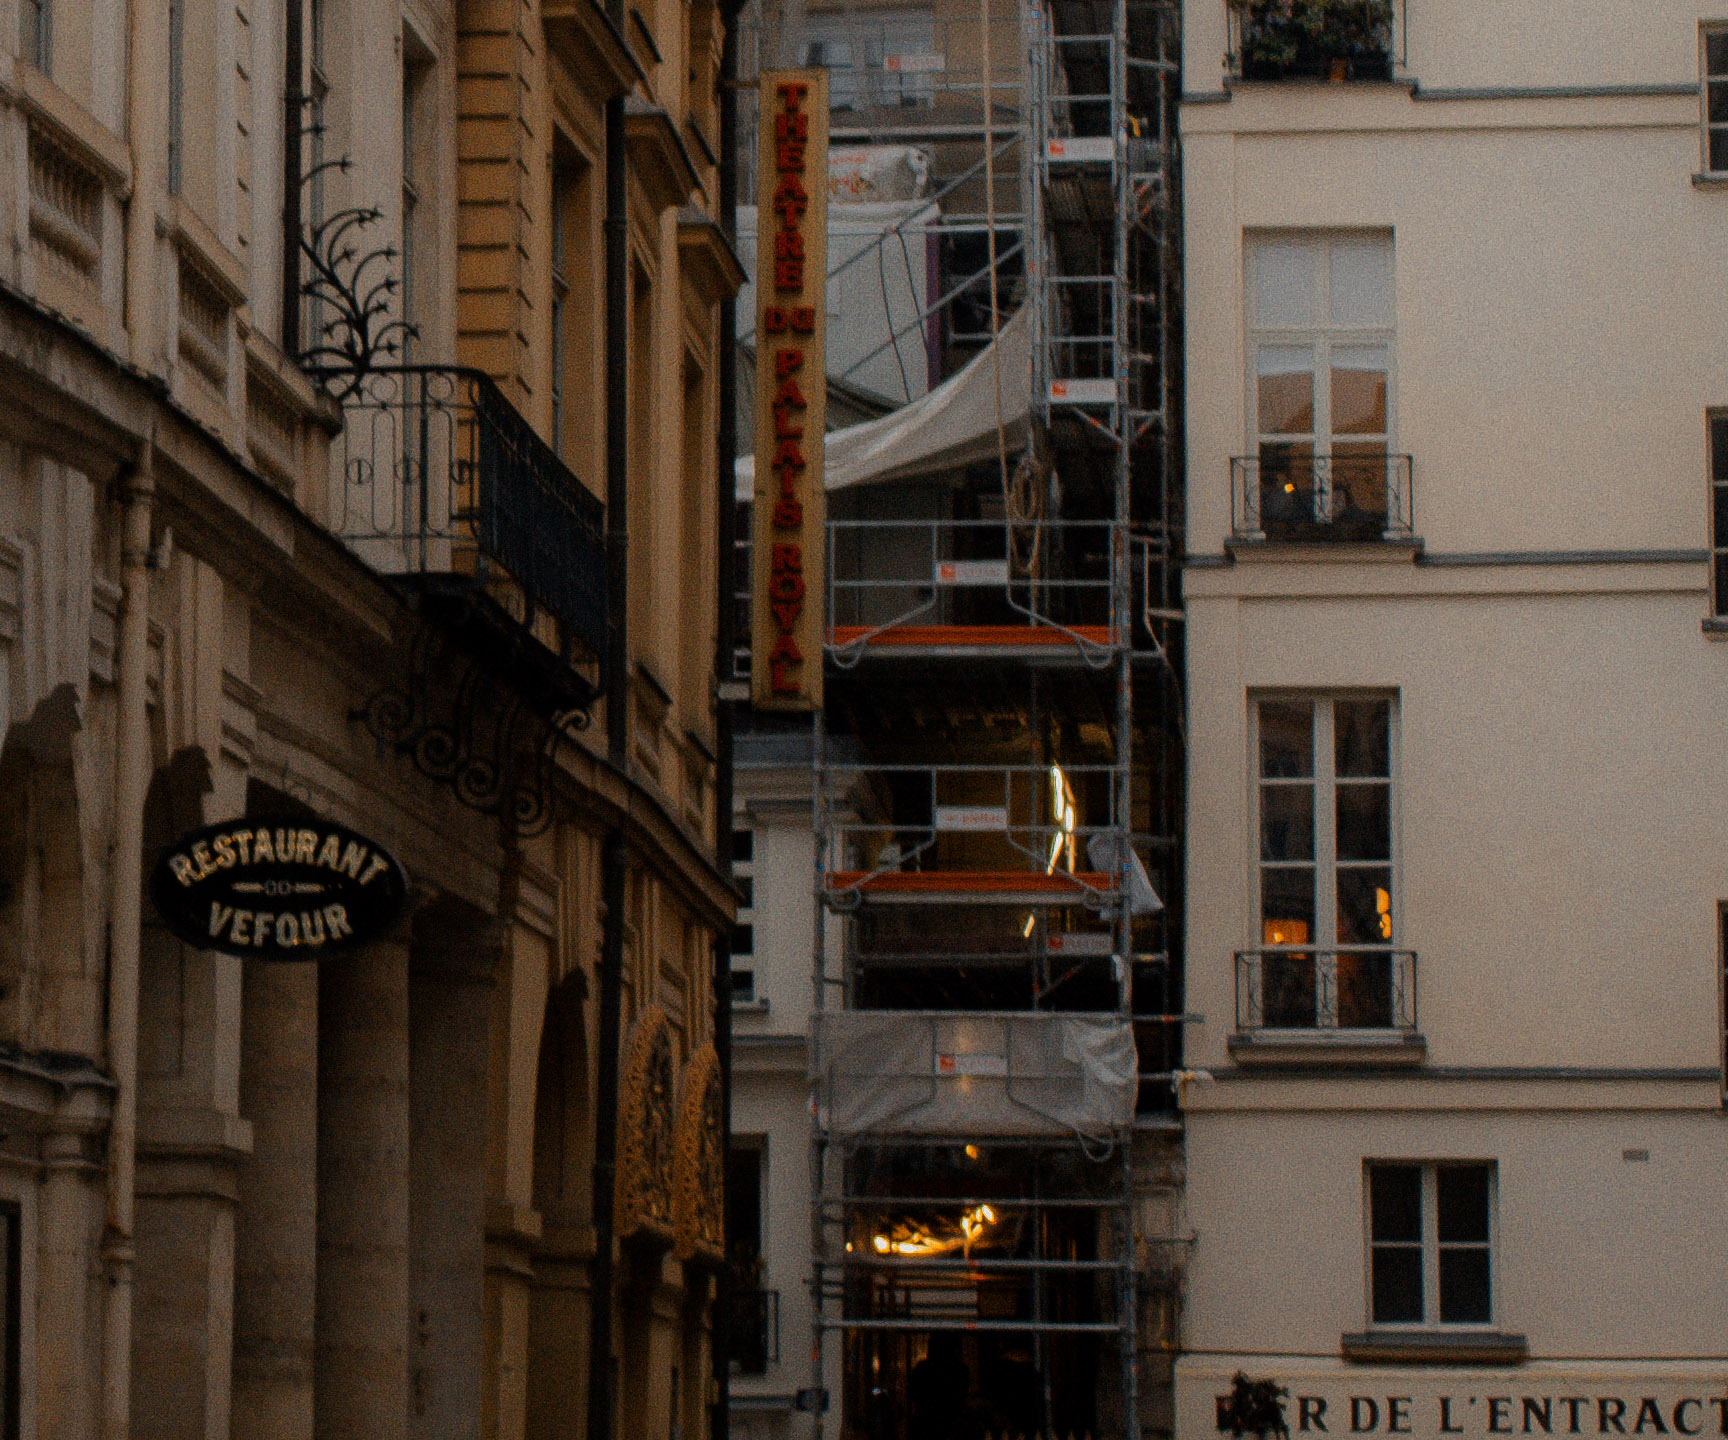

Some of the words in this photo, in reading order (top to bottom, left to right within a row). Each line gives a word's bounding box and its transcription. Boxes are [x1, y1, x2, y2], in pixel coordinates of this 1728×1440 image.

[775, 83, 808, 293] THEATRE
[772, 348, 807, 530] PALAIS
[770, 542, 805, 696] ROYAL
[166, 826, 390, 889] RESTAURANT
[207, 900, 354, 949] VEFOUR
[1350, 1396, 1413, 1433] DE
